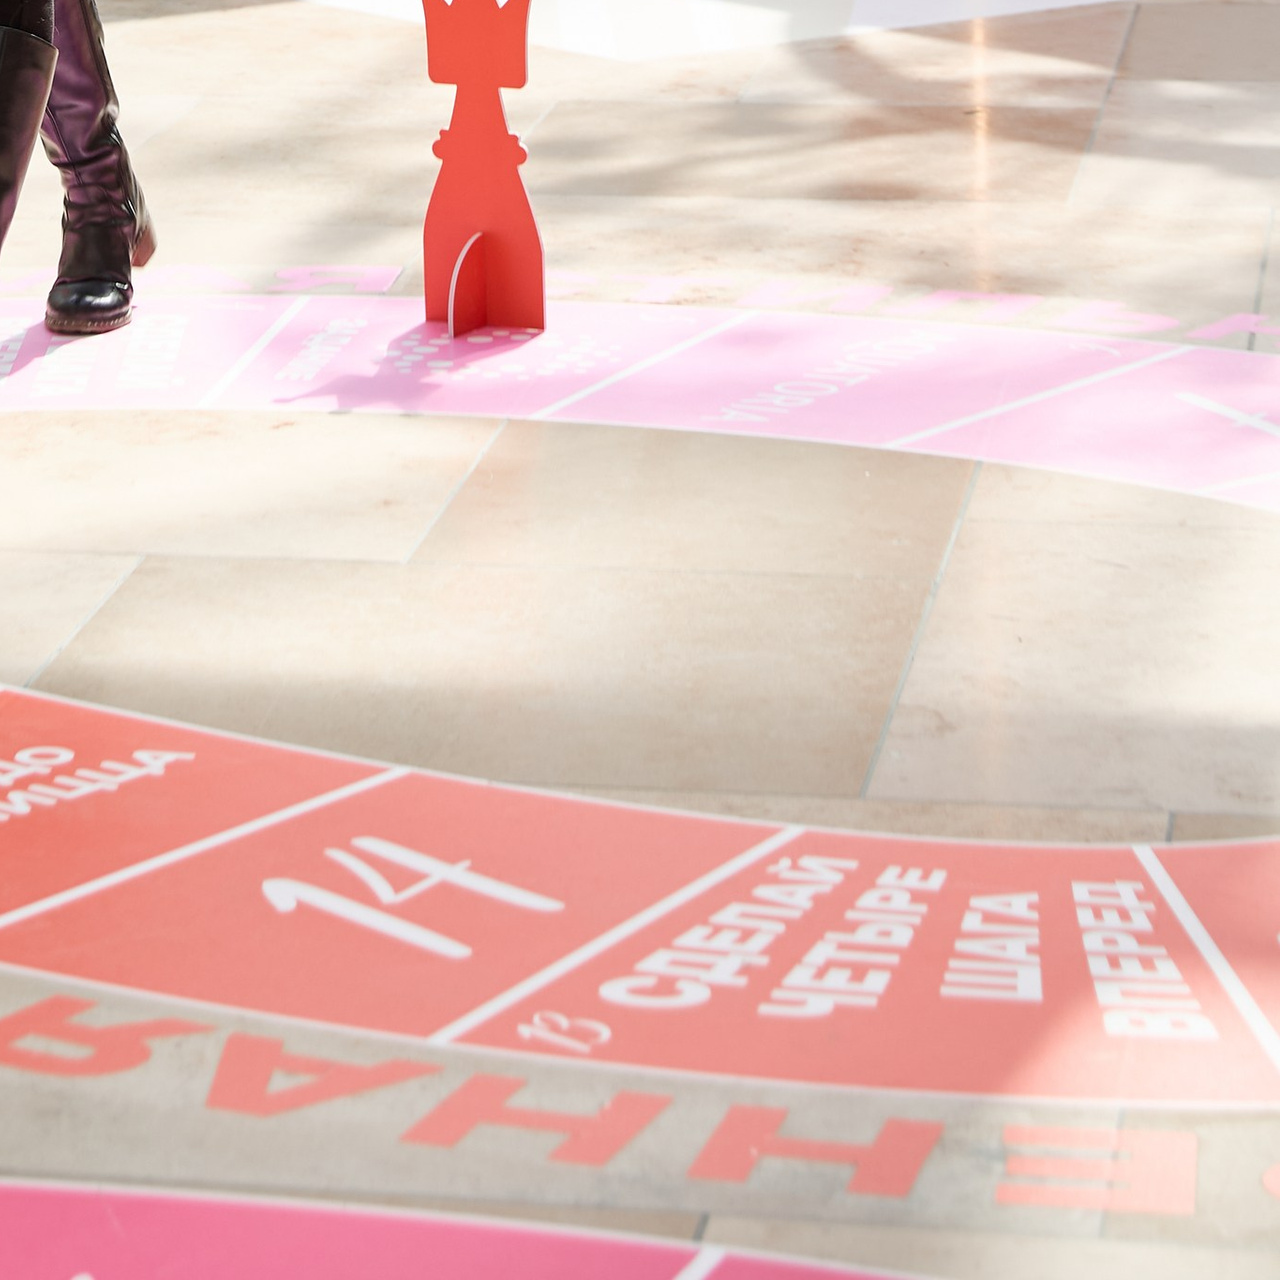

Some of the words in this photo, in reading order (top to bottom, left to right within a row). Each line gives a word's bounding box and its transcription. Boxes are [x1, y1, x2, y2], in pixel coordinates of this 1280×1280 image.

[263, 835, 566, 961] 14
[598, 853, 860, 1010] СДЕЛАЙ
[757, 864, 948, 1019] ЧЕТЫРЕ
[939, 891, 1044, 1003] ШАГА
[1071, 878, 1221, 1040] ВПЕРЕД
